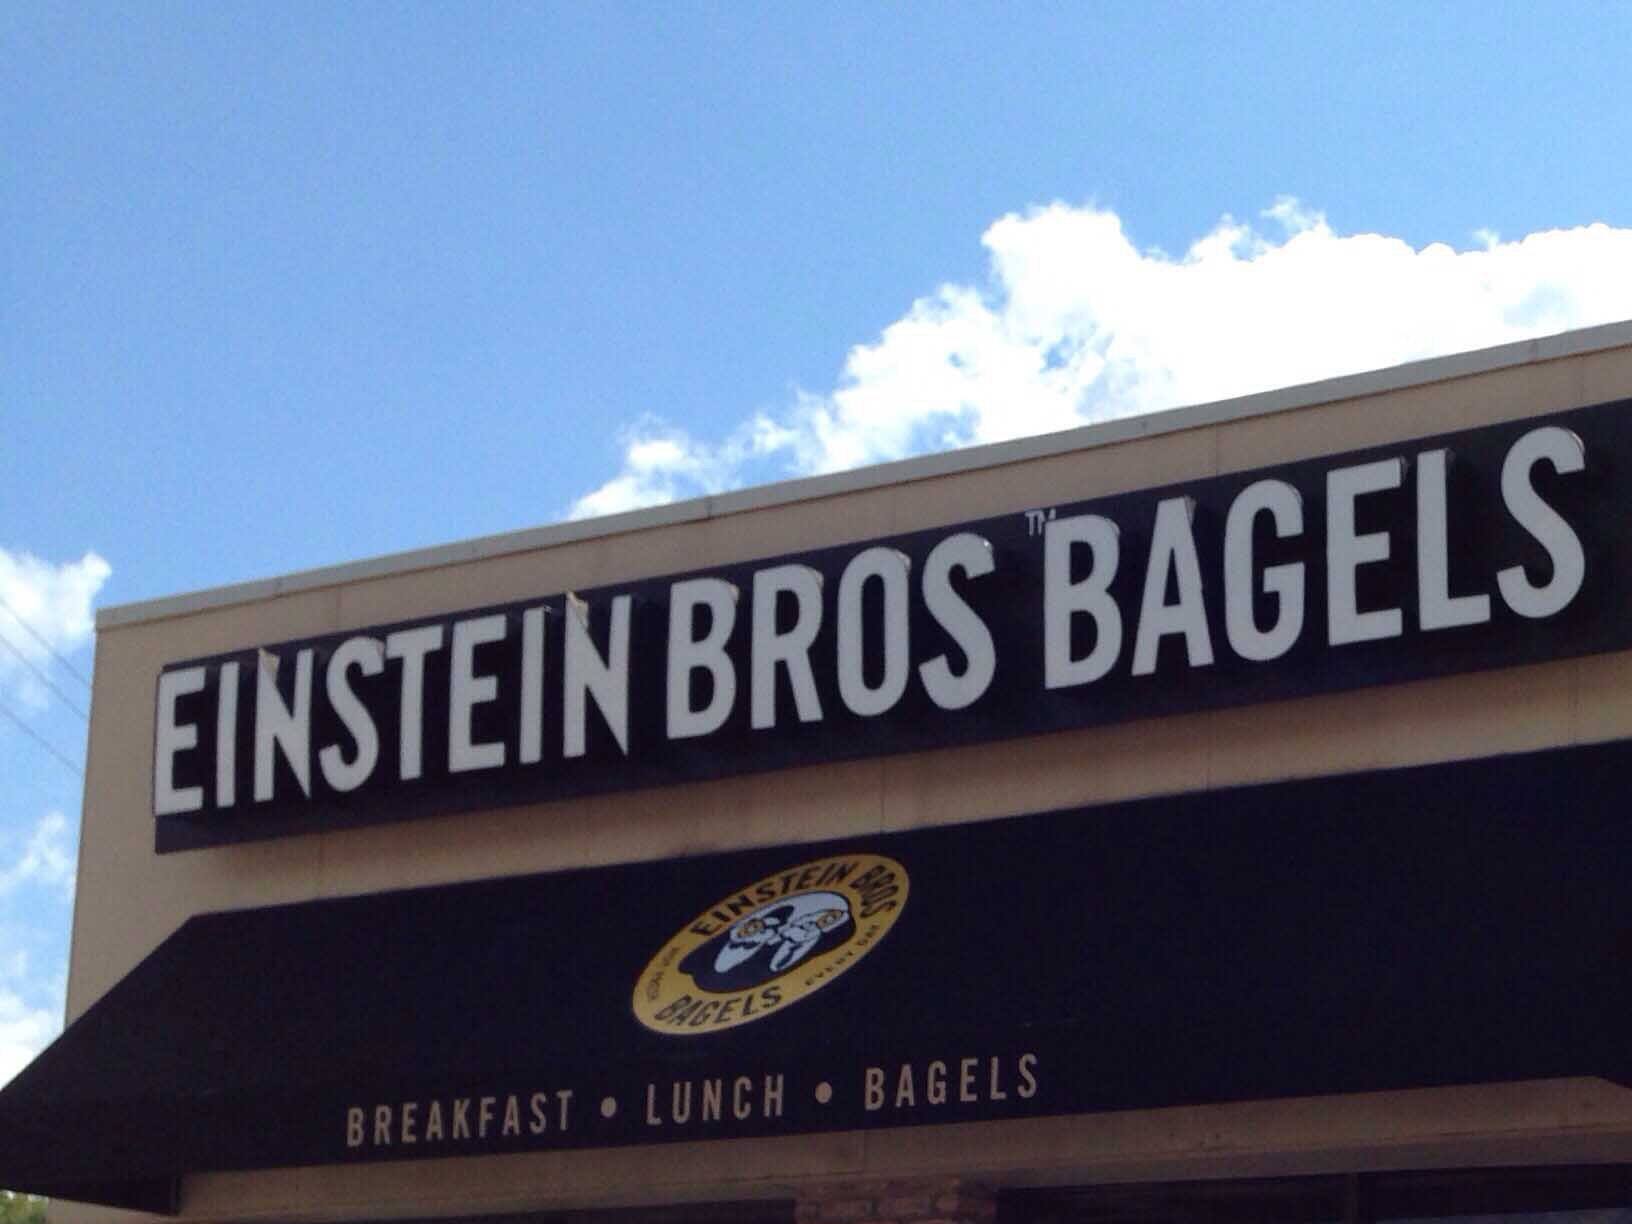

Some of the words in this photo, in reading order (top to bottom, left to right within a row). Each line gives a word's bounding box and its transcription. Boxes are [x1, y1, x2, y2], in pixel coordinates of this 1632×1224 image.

[155, 592, 632, 815] EINSTEIN
[666, 531, 998, 740] BROS
[1044, 425, 1587, 690] BAGELS
[692, 862, 858, 937] EINSTEIN
[848, 864, 899, 918] BROS
[654, 985, 782, 1026] BAGELS
[347, 1090, 575, 1148] BREAKFAST
[646, 1075, 785, 1126] LUNCH
[866, 1054, 1040, 1112] BAGELS
